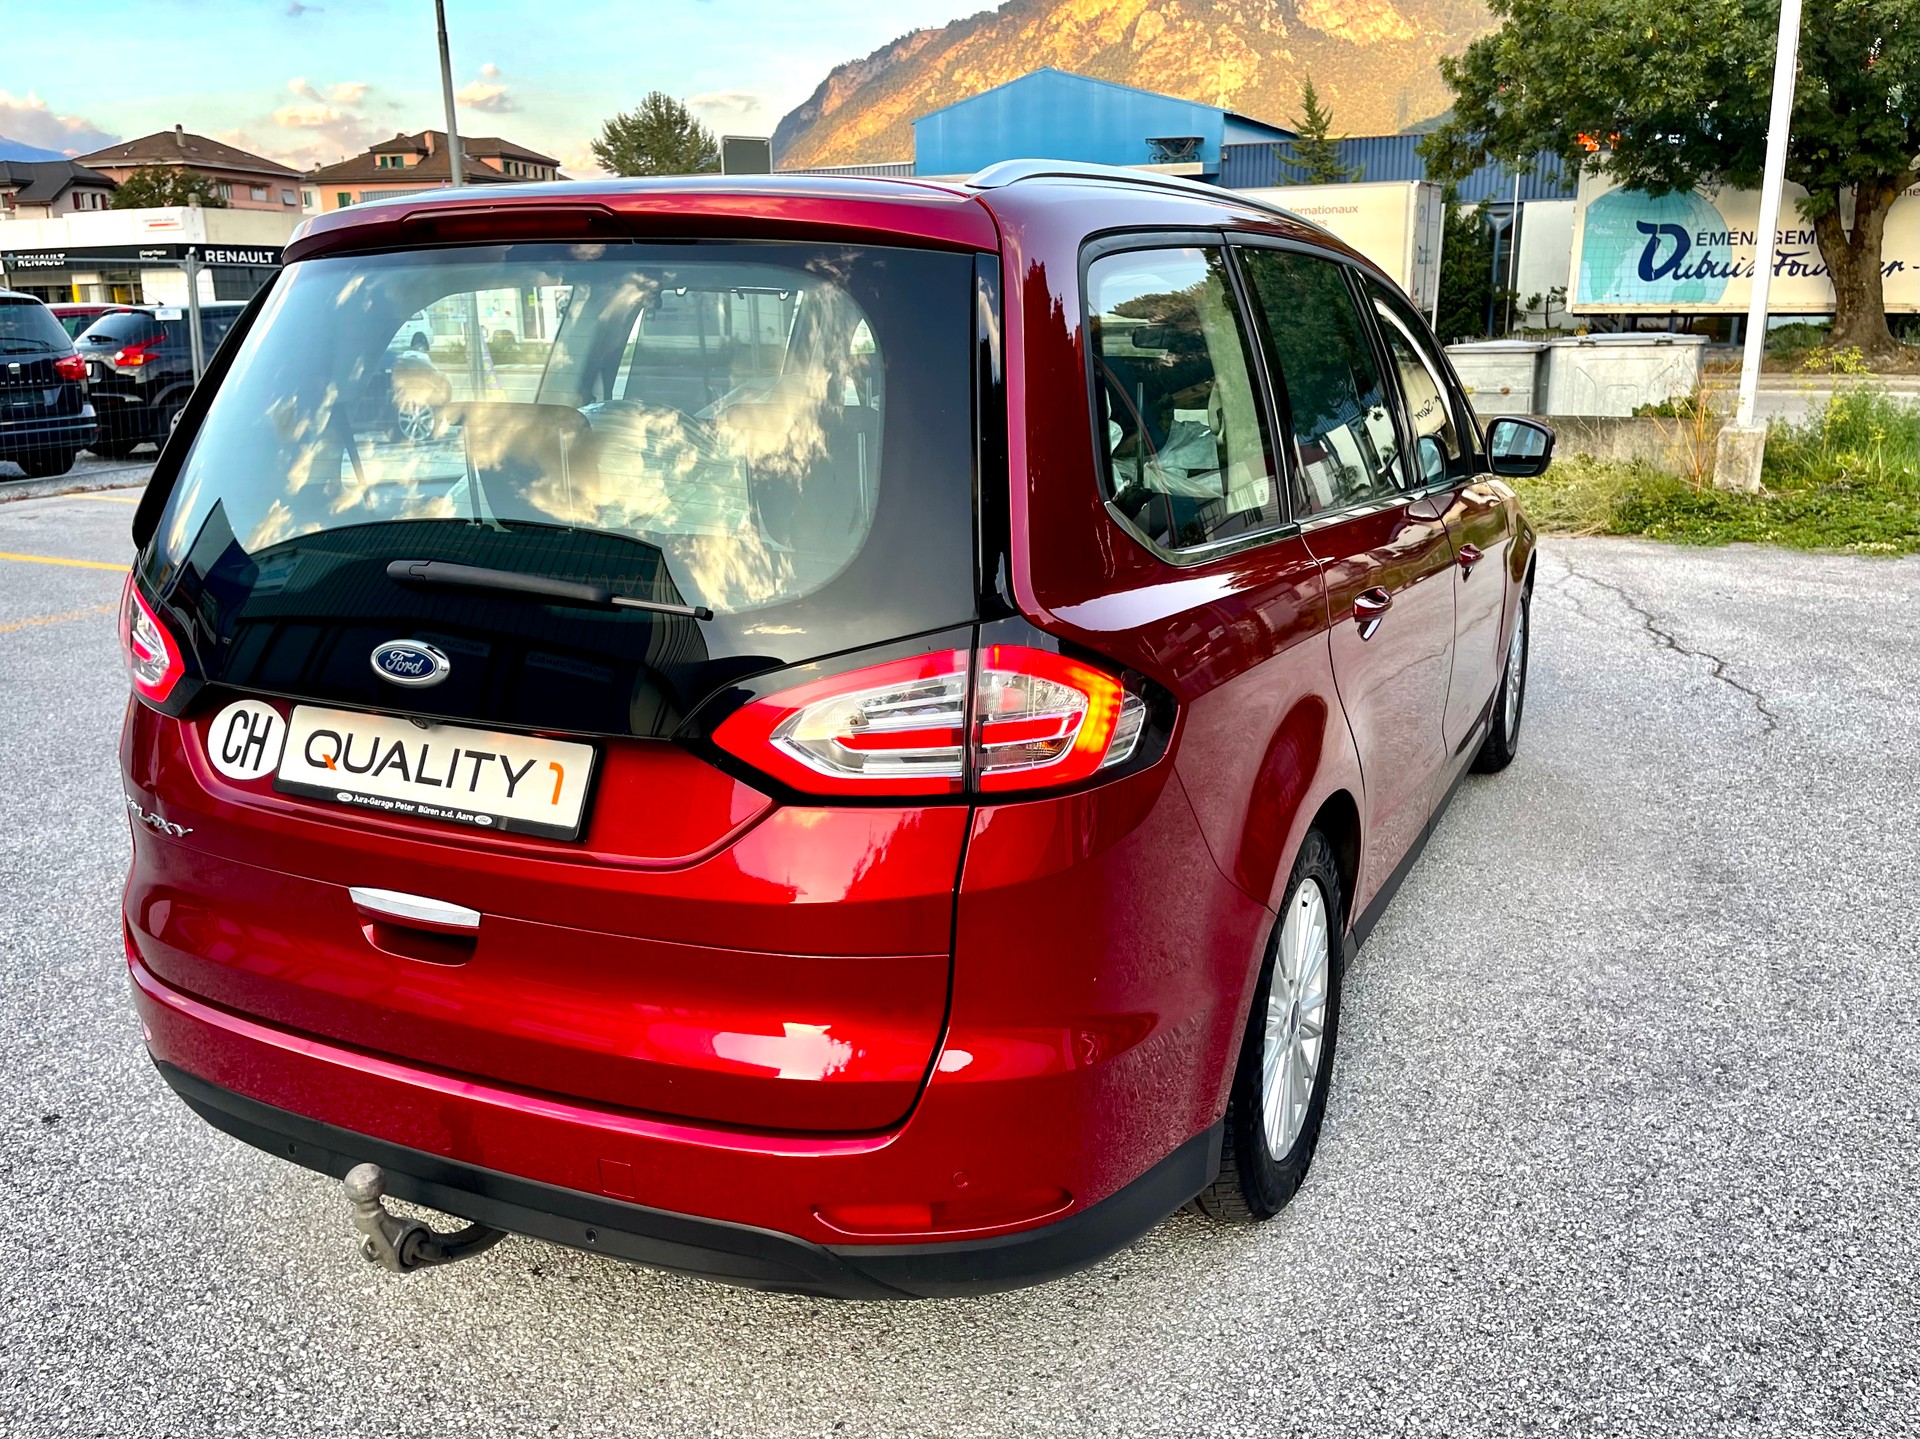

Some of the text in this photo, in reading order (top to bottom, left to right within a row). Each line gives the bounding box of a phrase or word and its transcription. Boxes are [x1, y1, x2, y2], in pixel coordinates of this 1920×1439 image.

[17, 252, 66, 268] RENAULT
[204, 249, 275, 265] RENAULT
[385, 650, 425, 675] Ford
[222, 709, 274, 771] CH
[304, 729, 537, 799] QUALITY
[353, 794, 394, 810] Jura-Garage
[395, 801, 415, 812] Peter
[417, 805, 440, 817] Büren
[455, 812, 475, 822] Aare
